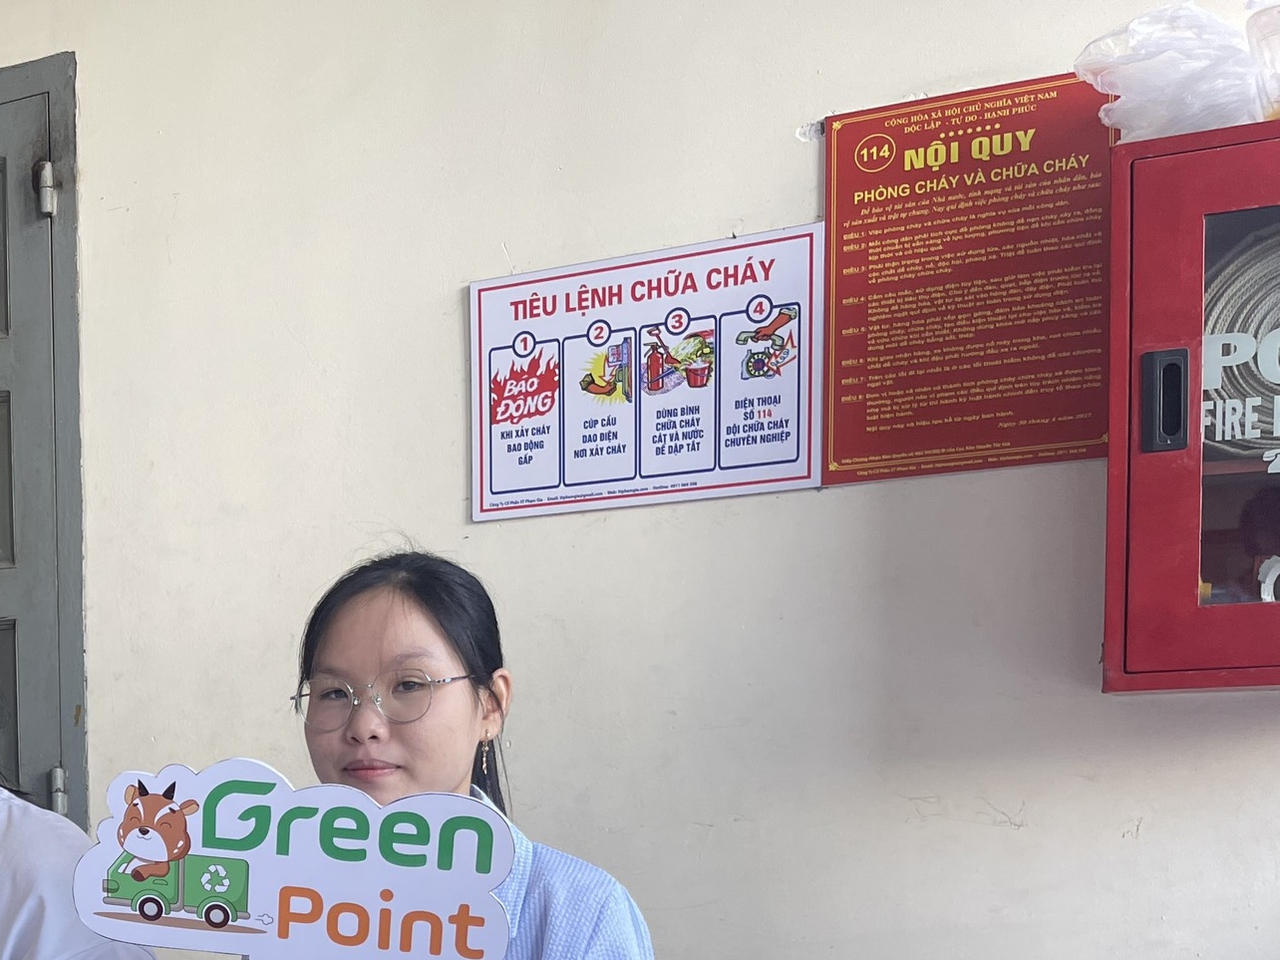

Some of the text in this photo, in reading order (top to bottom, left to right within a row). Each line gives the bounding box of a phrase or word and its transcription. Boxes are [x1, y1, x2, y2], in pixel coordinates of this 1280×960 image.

[944, 106, 961, 118] HỘI
[1014, 94, 1035, 106] VIỆT
[1037, 90, 1058, 101] NAM
[965, 114, 978, 123] DO
[1012, 104, 1037, 115] PHÚC
[859, 143, 891, 163] 114
[904, 128, 1036, 172] NỘI QUY
[854, 153, 1090, 205] PHÒNG CHÁY VÀ CHỮA CHÁY
[510, 256, 776, 321] TIÊU LỆNH CHỮA CHÁY
[753, 301, 765, 315] 4
[671, 314, 683, 329] 3
[594, 326, 604, 340] 2
[520, 337, 528, 351] 1
[503, 375, 539, 397] BÁO
[496, 391, 553, 424] ĐỘNG
[756, 395, 781, 407] THOẠI
[656, 405, 700, 419] DÙNG BÌNH
[757, 409, 773, 419] 114
[1203, 397, 1262, 441] FIRE
[500, 430, 513, 440] KHI
[531, 424, 551, 436] CHÁY
[656, 417, 701, 431] CHỮA CHÁY
[742, 421, 765, 433] CHỮA
[767, 418, 790, 430] CHÁY
[669, 431, 680, 442] VÀ
[725, 431, 791, 448] CHUYÊN NGHIỆP
[606, 444, 627, 455] CHÁY
[201, 779, 494, 874] Green
[277, 885, 486, 960] Point
